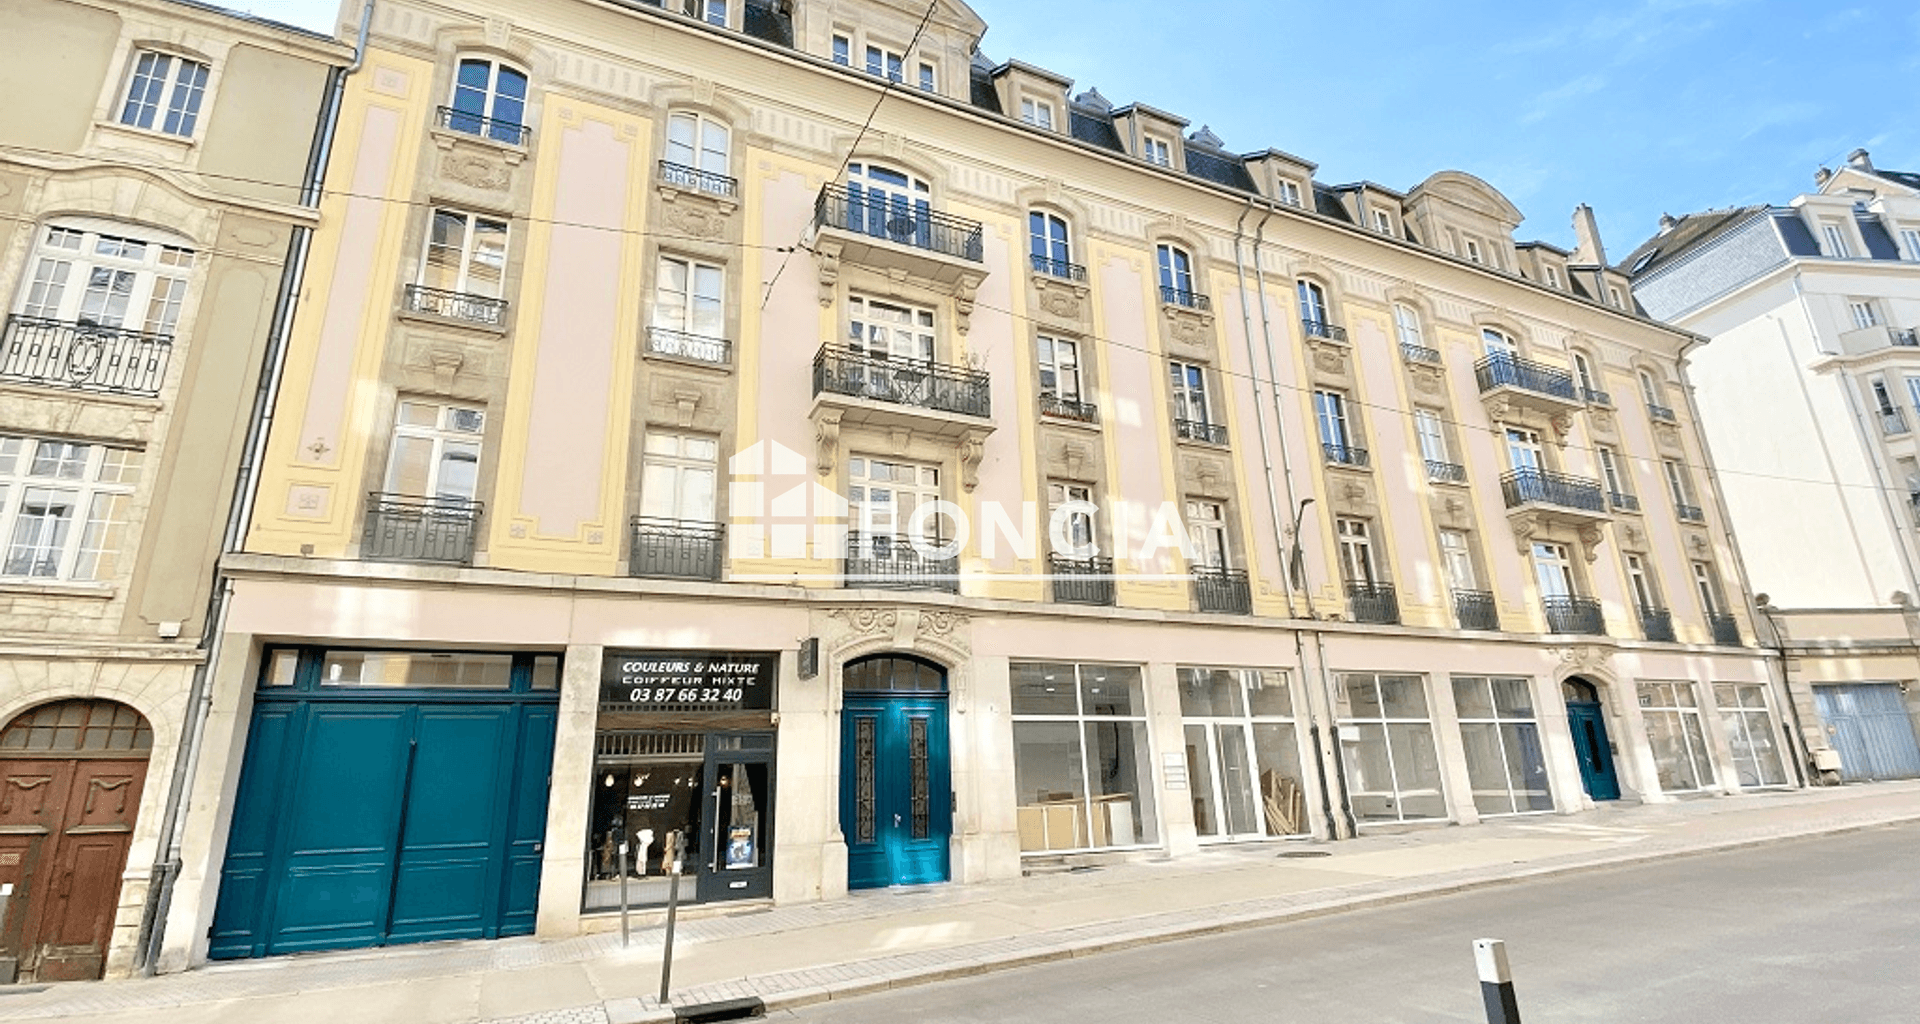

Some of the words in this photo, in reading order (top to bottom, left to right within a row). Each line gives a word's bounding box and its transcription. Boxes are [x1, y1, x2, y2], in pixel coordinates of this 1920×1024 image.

[622, 661, 691, 673] COULEURS
[693, 661, 704, 673] &
[707, 662, 760, 674] NATURE
[622, 676, 702, 685] COIFFEUR
[712, 677, 756, 686] MIXTE
[630, 688, 651, 702] 03
[654, 688, 676, 702] 87
[678, 688, 698, 702] 66
[700, 688, 720, 702] 32
[722, 688, 743, 702] 40
